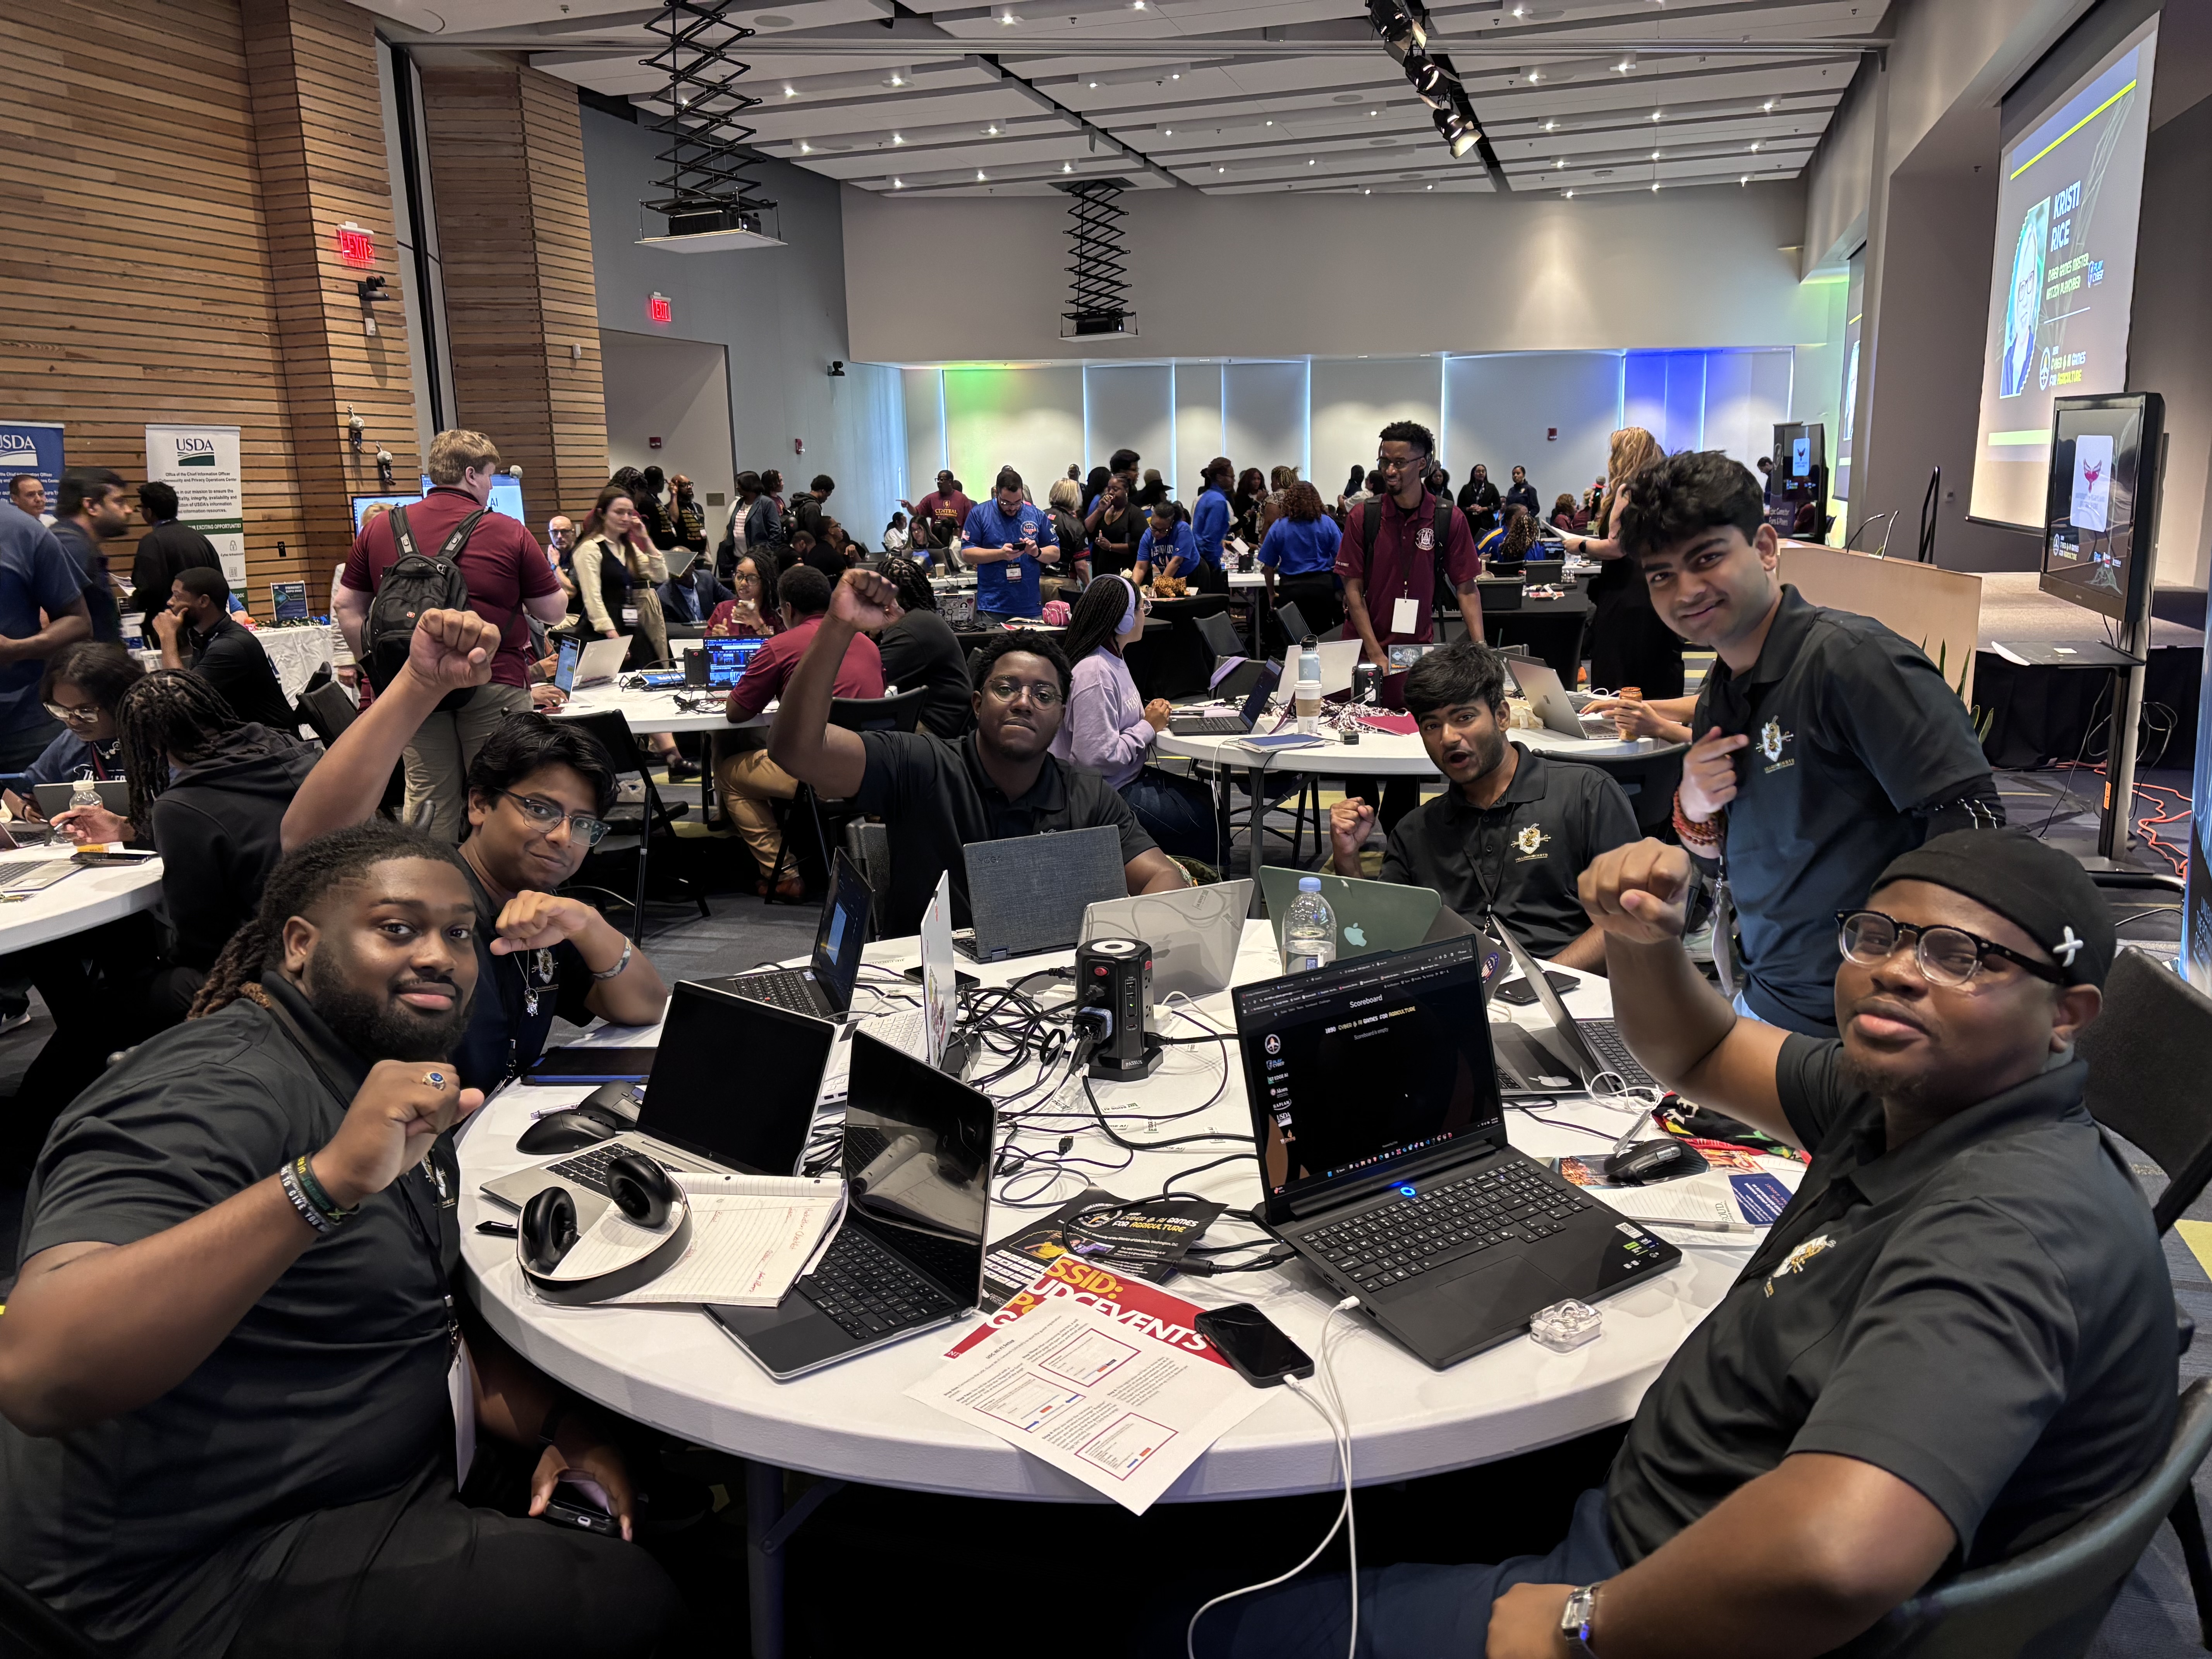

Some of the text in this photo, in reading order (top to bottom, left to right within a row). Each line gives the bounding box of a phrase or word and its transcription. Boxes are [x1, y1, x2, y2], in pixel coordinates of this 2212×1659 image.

[2053, 180, 2081, 219] KRISTI
[2051, 219, 2071, 252] RICE
[347, 235, 368, 259] EXIT
[655, 302, 667, 319] EXIT
[176, 438, 214, 451] USDA
[491, 498, 498, 507] AI
[1349, 994, 1383, 1008] Scoreboard
[1388, 1006, 1416, 1018] AGRICULTURE
[1273, 1100, 1290, 1108] KAPLAN
[1276, 1112, 1291, 1120] USDA
[1716, 1202, 1731, 1222] ROUD.
[1129, 1222, 1187, 1233] AGRICULTURE
[1166, 1217, 1199, 1227] GAMES
[1046, 1258, 1123, 1299] SSID:
